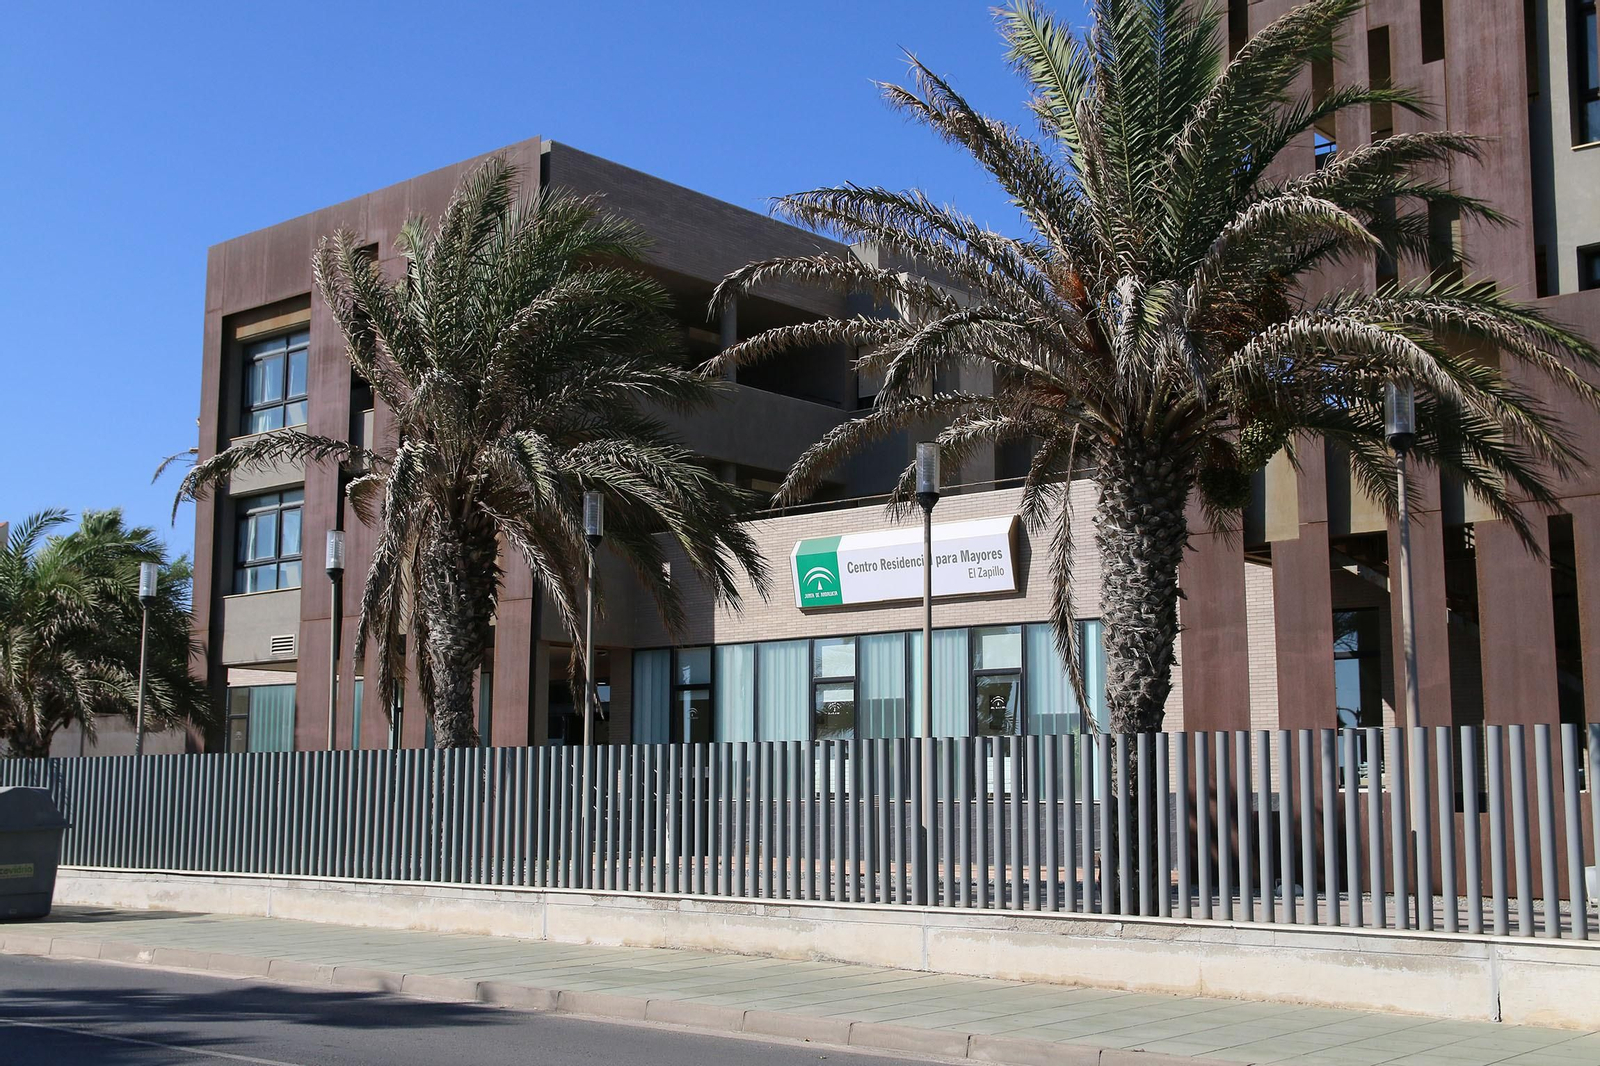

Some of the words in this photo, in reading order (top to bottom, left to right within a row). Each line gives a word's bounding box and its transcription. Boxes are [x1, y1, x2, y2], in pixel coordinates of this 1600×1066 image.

[847, 561, 878, 574] Centro
[880, 553, 933, 571] Residencil
[935, 553, 958, 567] para
[960, 549, 1003, 564] Mayores
[968, 567, 976, 579] El
[978, 565, 1005, 579] Zapillo
